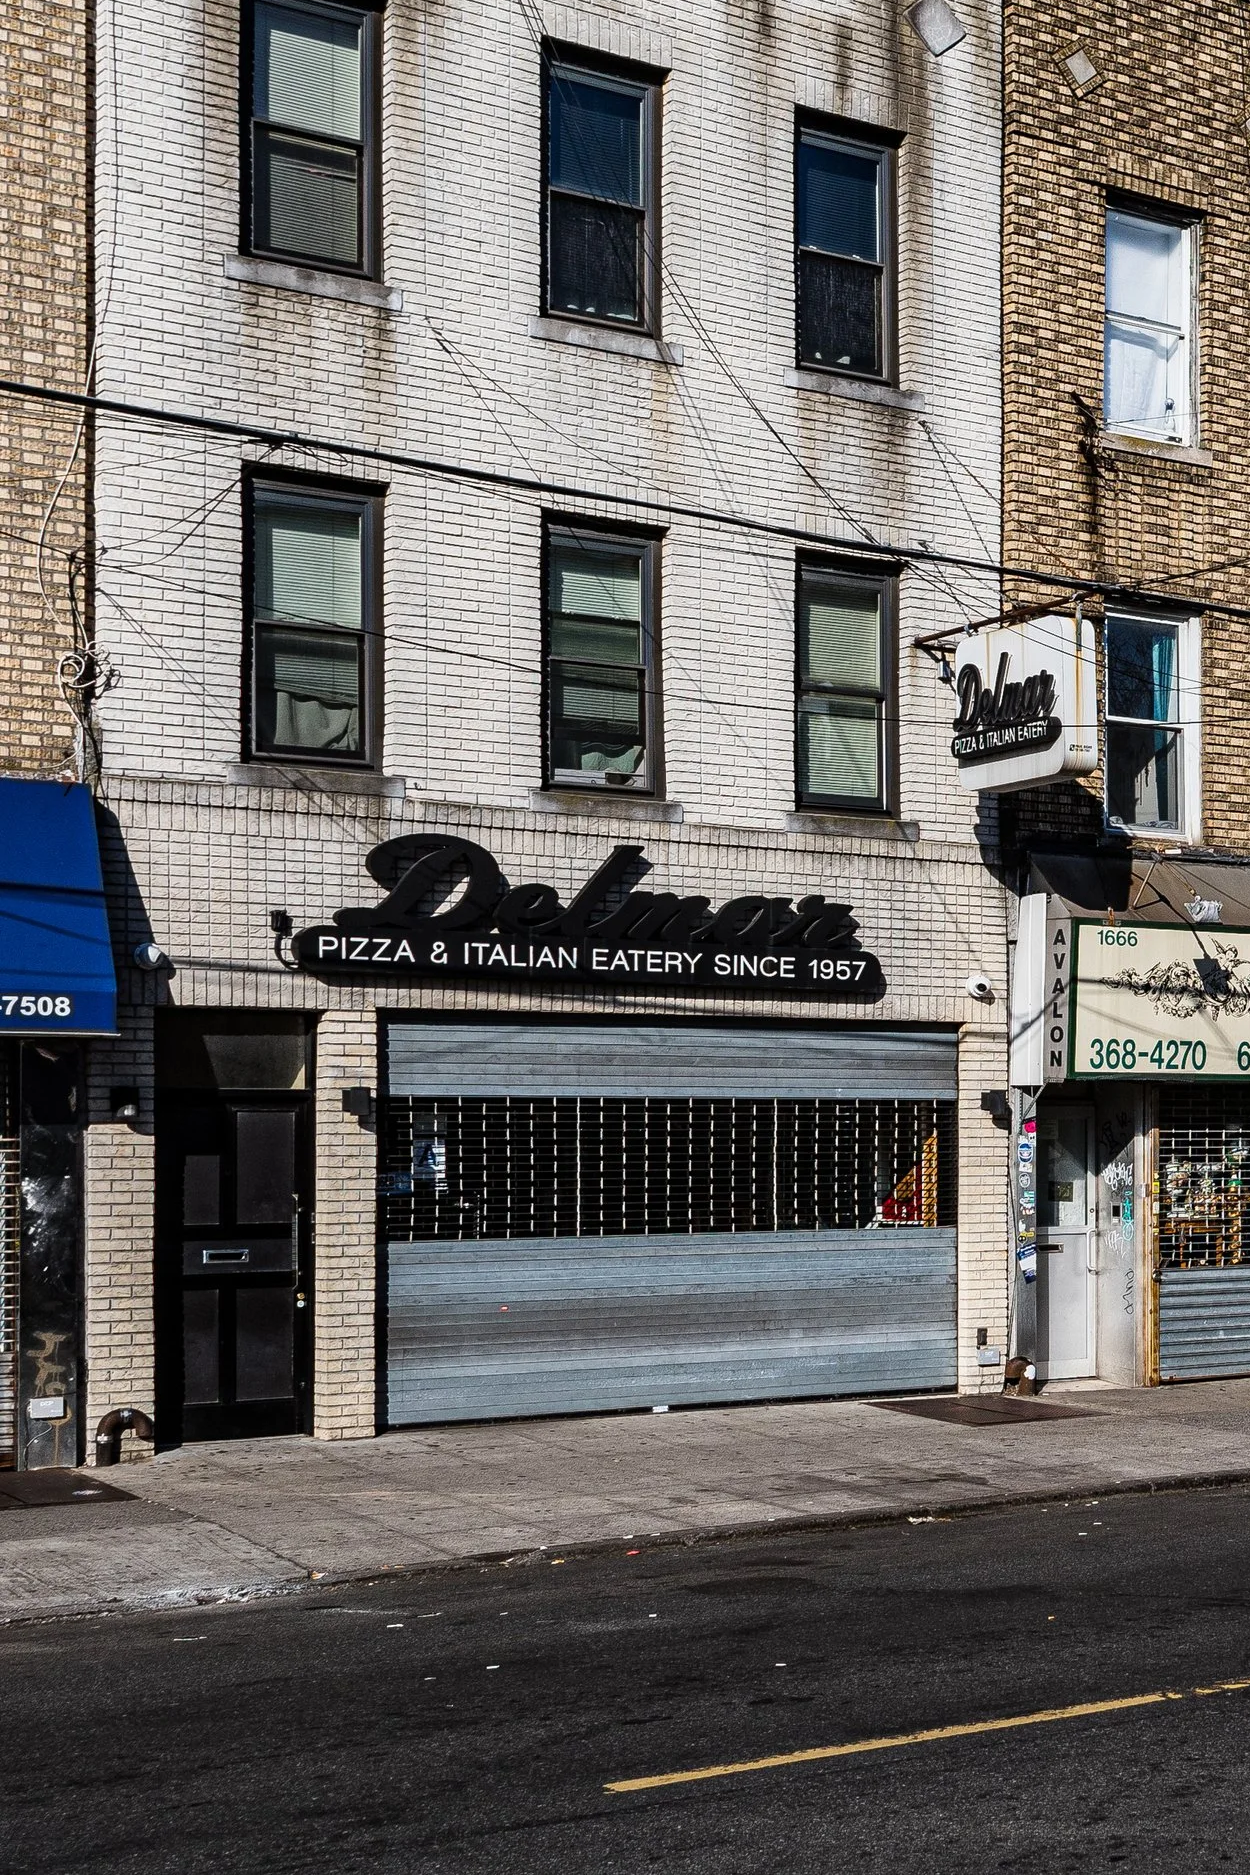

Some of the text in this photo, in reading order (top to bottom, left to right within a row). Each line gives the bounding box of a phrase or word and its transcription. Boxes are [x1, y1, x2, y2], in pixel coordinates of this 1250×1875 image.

[953, 652, 1057, 732] Delmar
[954, 719, 1049, 755] PIZZA & ITALIAN EATERY
[332, 833, 866, 947] Delmar
[318, 936, 867, 981] PIZZA & ITALIAN EATERY SINCE 1957
[1097, 930, 1138, 947] 1666
[1050, 928, 1068, 1067] AVALON
[1089, 1038, 1207, 1070] 368-4270
